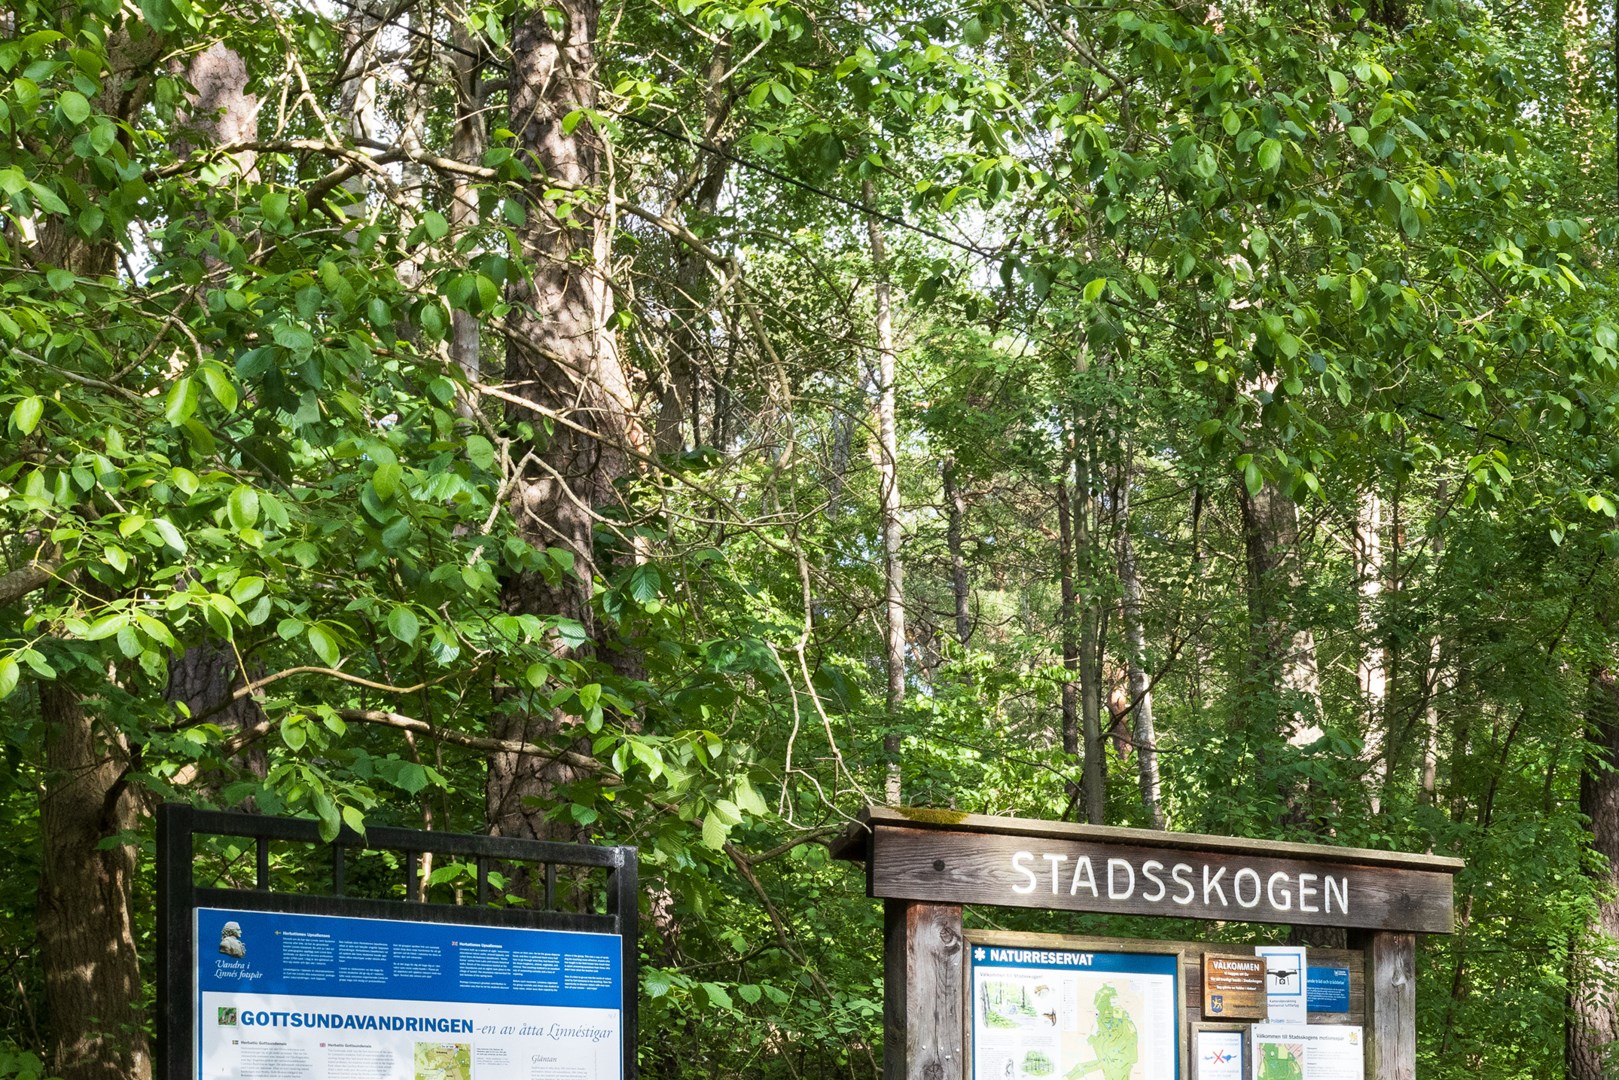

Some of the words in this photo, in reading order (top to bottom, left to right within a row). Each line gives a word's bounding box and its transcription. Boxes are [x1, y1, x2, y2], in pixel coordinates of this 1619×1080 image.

[1011, 850, 1349, 915] STADSSKOGEN
[215, 959, 246, 969] Vandra
[990, 949, 1094, 966] NATURRESERVAT
[1213, 960, 1260, 971] VÄLKOMMEN
[214, 968, 239, 979] Linnés
[238, 969, 264, 981] fotspår
[240, 1010, 474, 1034] GOTTSUNDAVANDRINGEN
[500, 1025, 515, 1035] av
[519, 1023, 544, 1037] åtta
[547, 1022, 613, 1042] Linnéstigar
[531, 1054, 558, 1064] Gläntan
